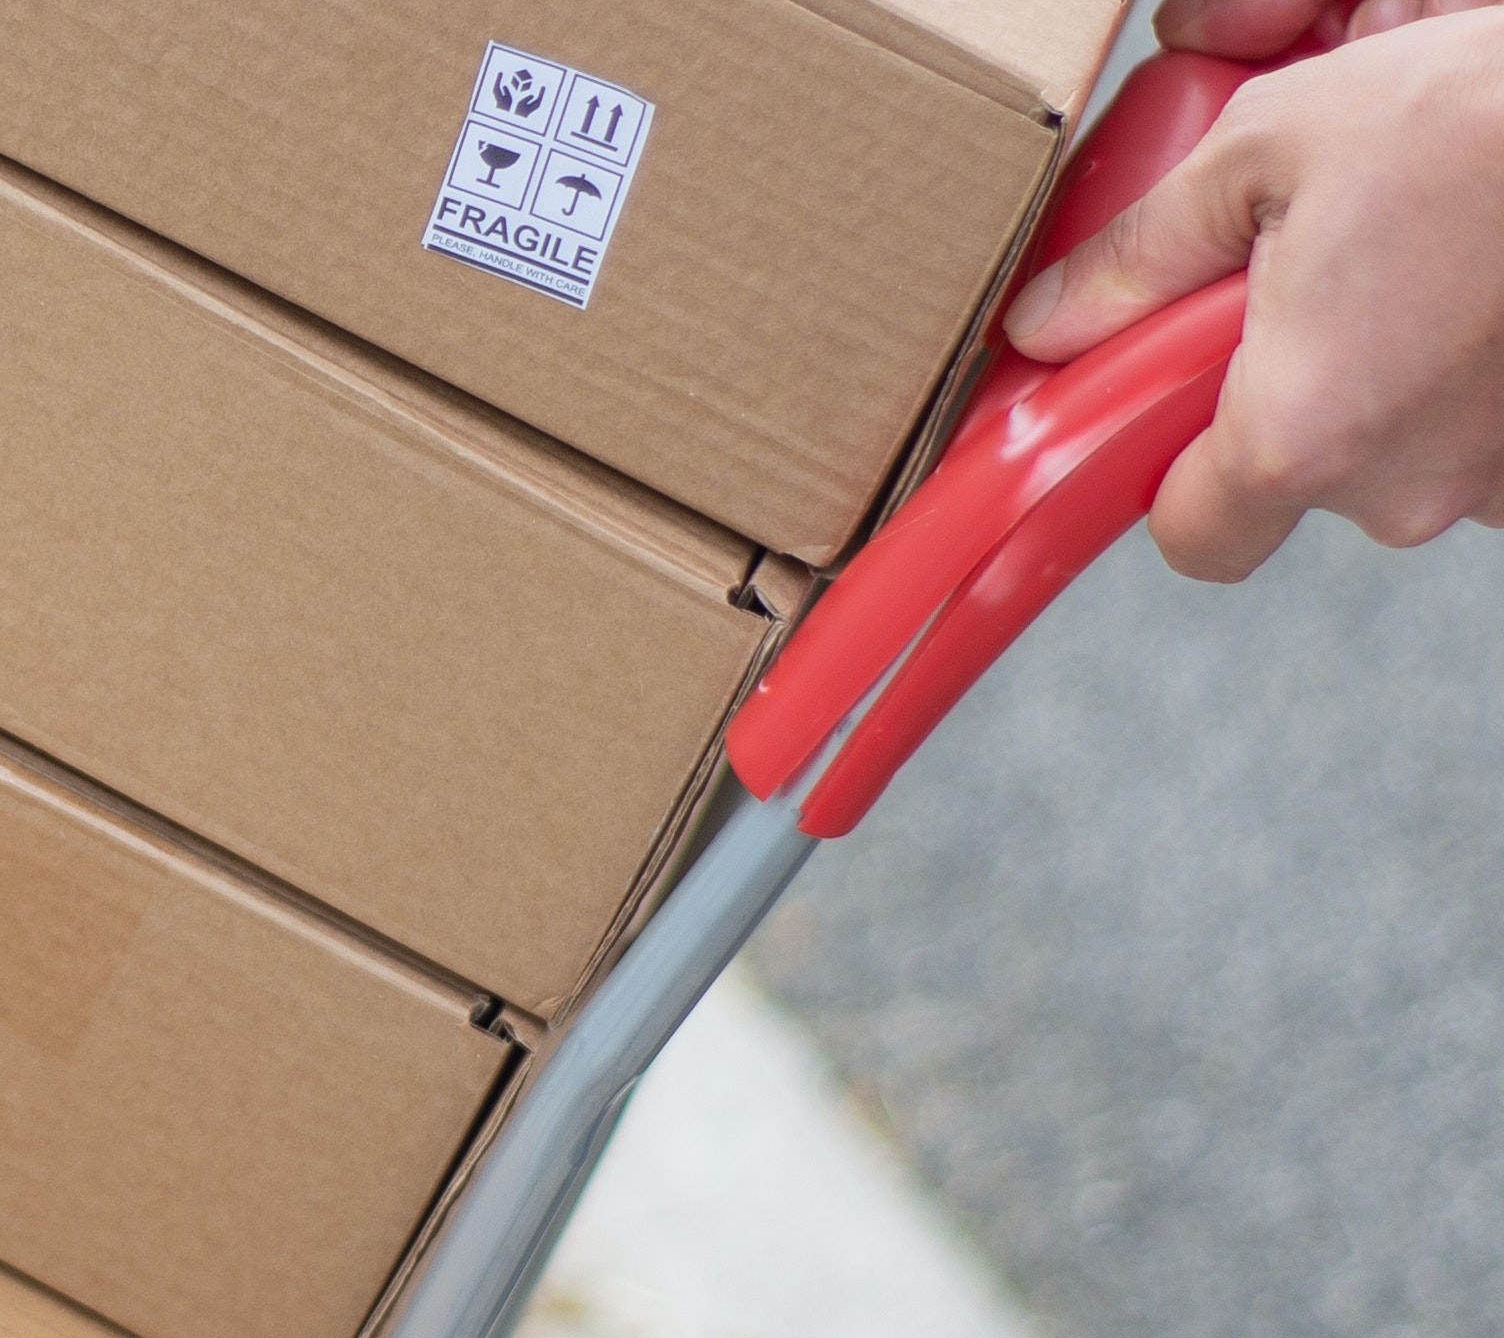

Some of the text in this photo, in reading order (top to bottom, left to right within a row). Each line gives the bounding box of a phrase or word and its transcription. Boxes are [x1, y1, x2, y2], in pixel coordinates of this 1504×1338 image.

[432, 233, 586, 297] PLEASE, HANDLE WITH CARE
[437, 196, 598, 275] FRAGILE
